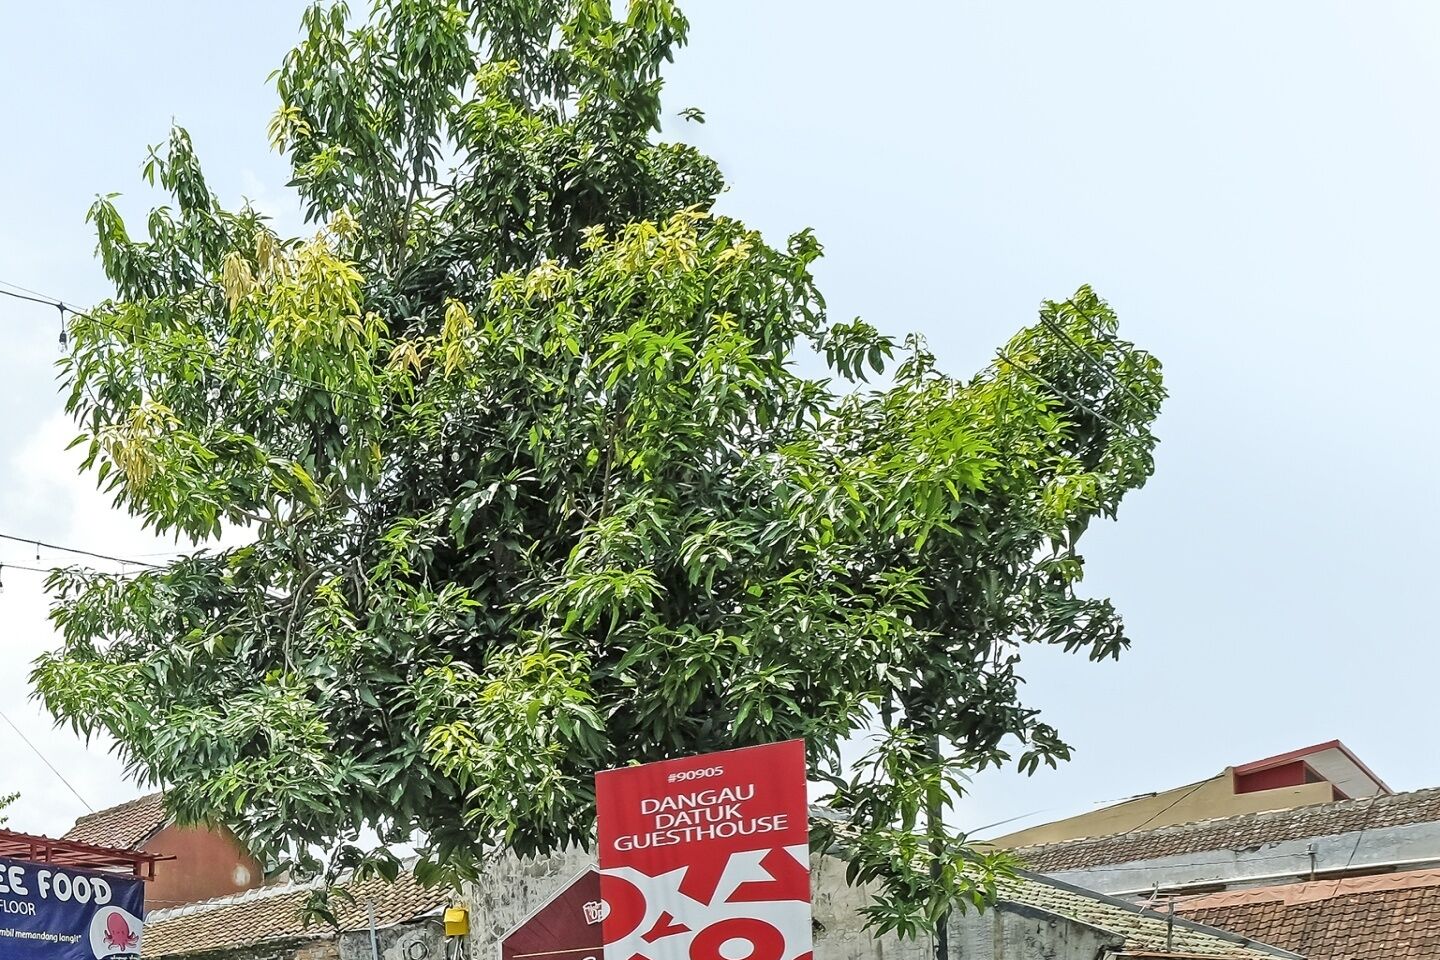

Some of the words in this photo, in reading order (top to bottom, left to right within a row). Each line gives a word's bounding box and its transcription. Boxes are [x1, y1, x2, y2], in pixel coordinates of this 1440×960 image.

[667, 766, 724, 784] #90905
[641, 783, 755, 815] DANGAU
[656, 803, 743, 830] DATUK
[614, 814, 789, 852] GUESTHOUSE
[37, 869, 112, 905] FOOD
[15, 930, 58, 943] memandang
